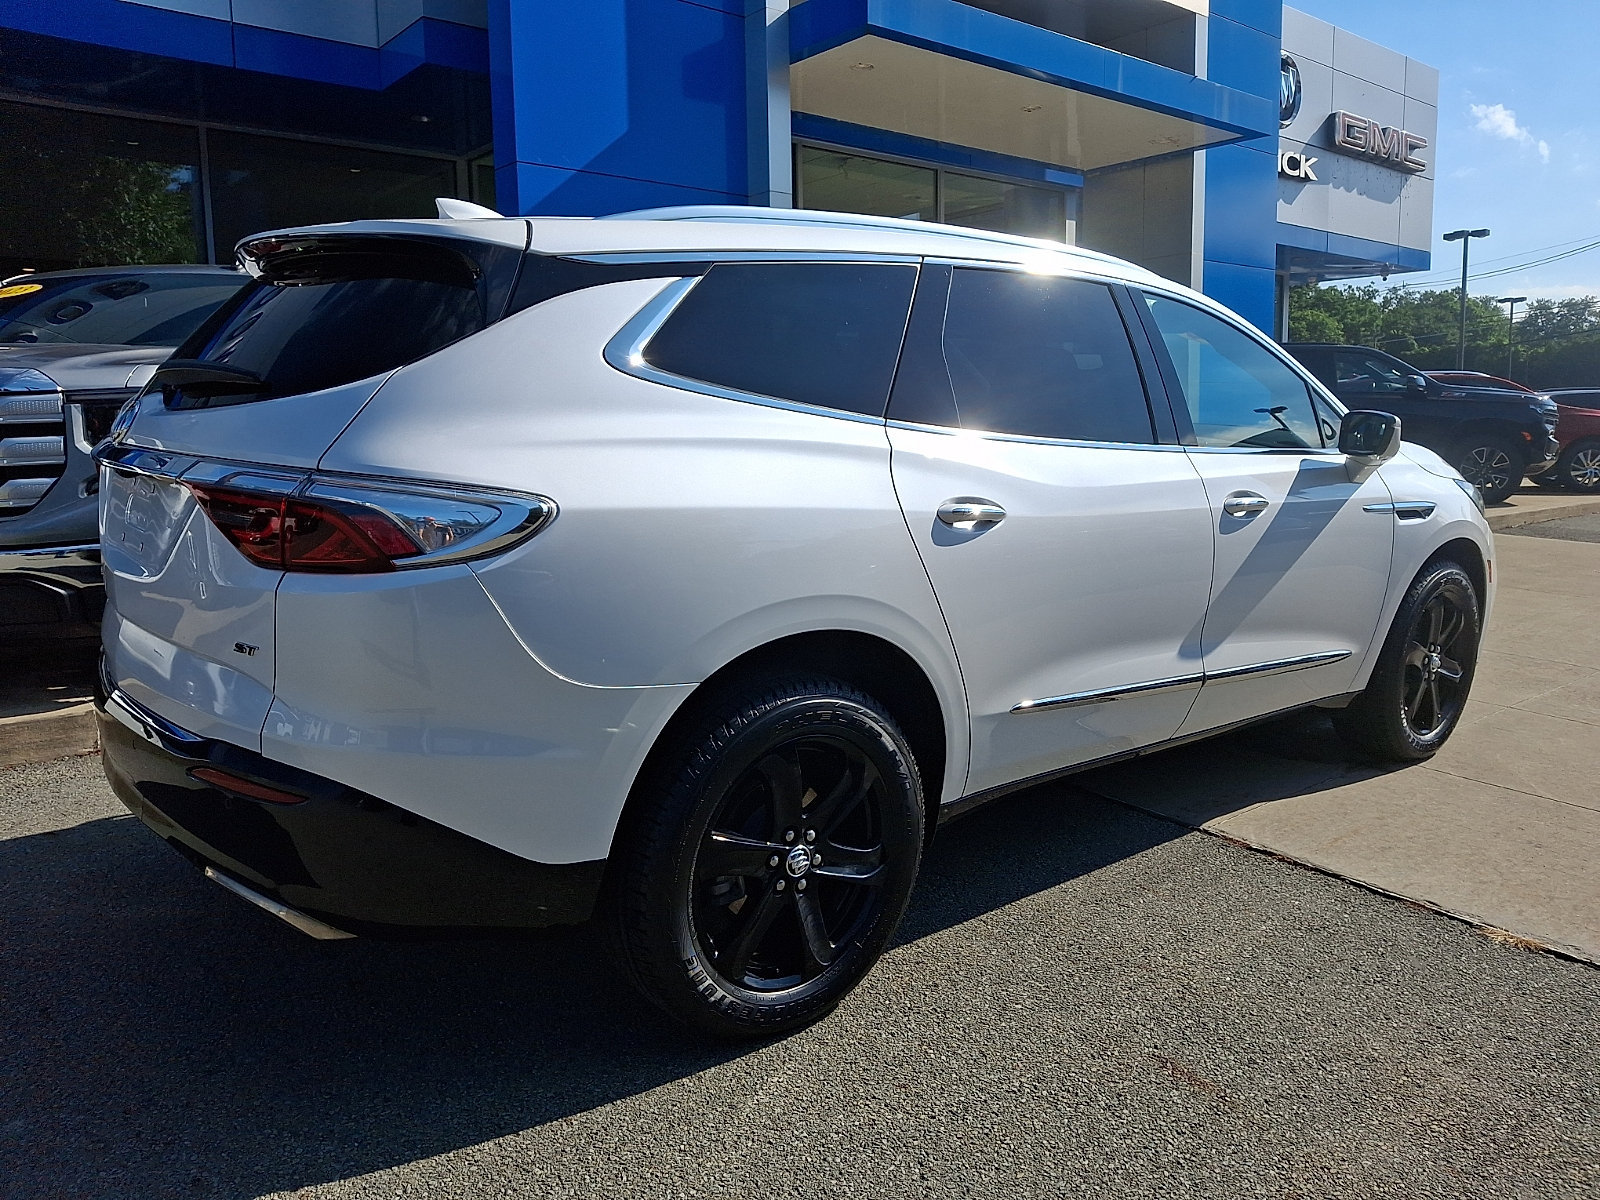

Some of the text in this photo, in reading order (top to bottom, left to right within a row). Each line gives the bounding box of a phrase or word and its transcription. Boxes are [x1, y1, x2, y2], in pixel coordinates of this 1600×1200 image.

[1336, 110, 1428, 172] GMC
[1278, 148, 1318, 181] ICK
[233, 641, 260, 657] ST
